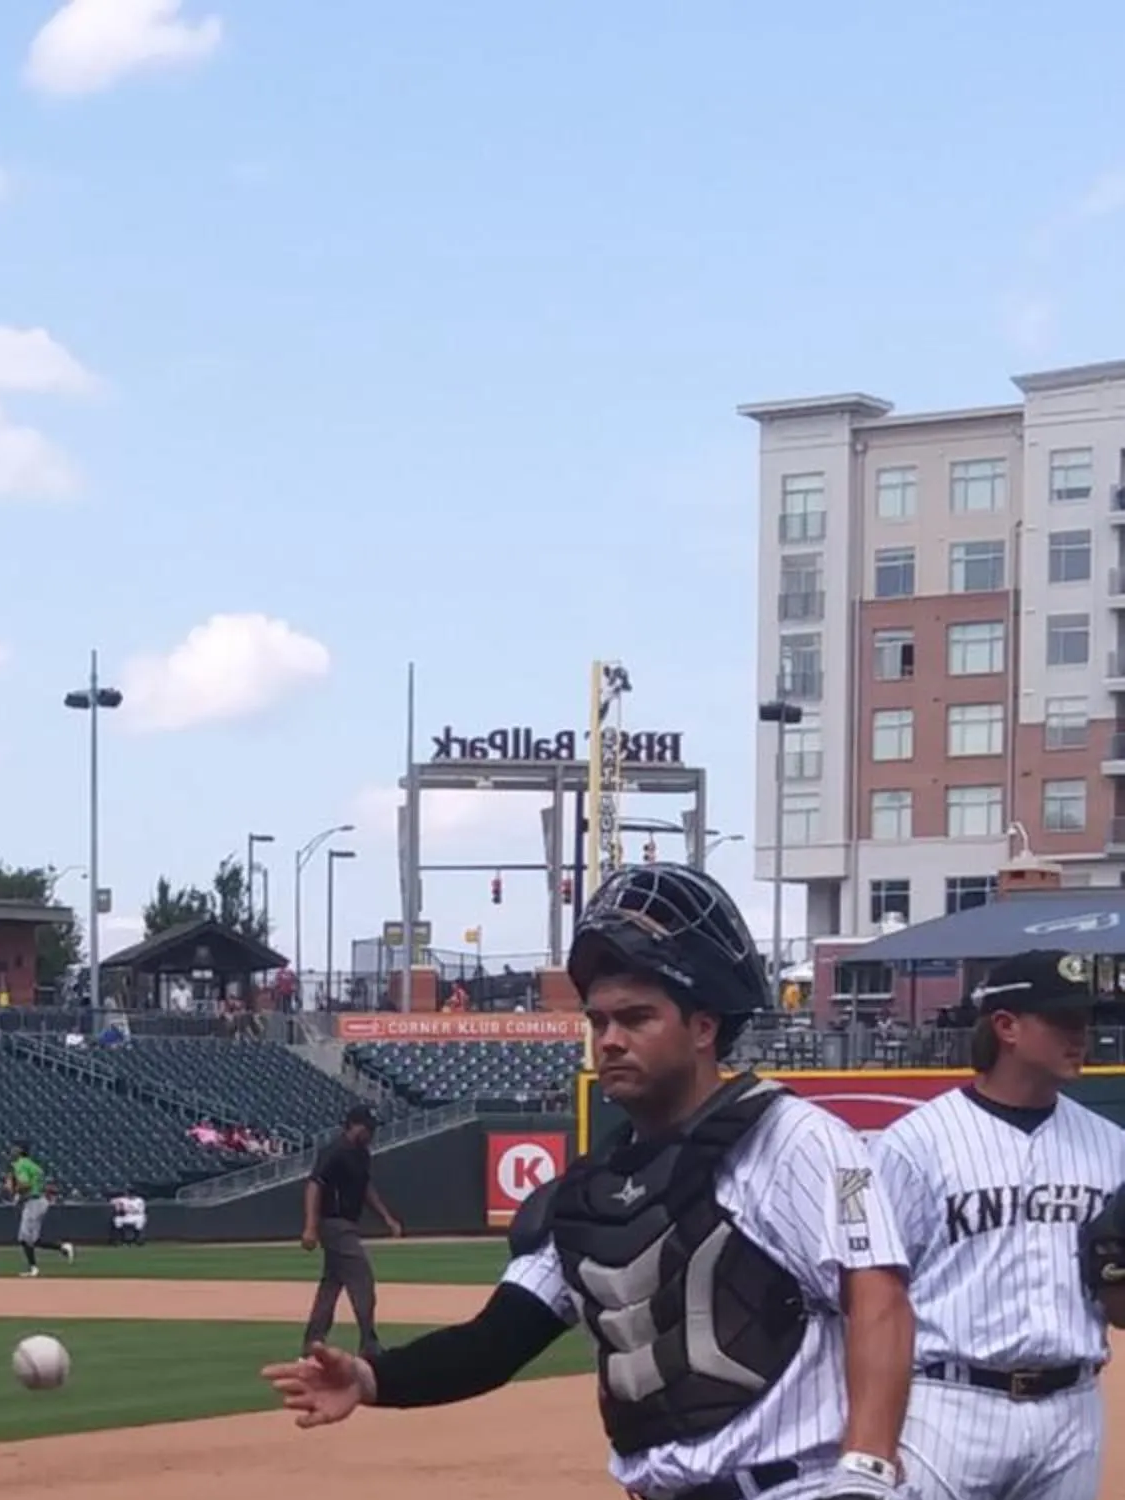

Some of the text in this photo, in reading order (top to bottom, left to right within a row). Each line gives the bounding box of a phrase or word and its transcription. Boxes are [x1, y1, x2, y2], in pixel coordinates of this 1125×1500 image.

[388, 1020, 452, 1034] CORNER
[458, 1019, 501, 1034] KLUB
[506, 1019, 568, 1035] COMING
[513, 1156, 545, 1188] K
[945, 1183, 1115, 1245] KNIGHT
